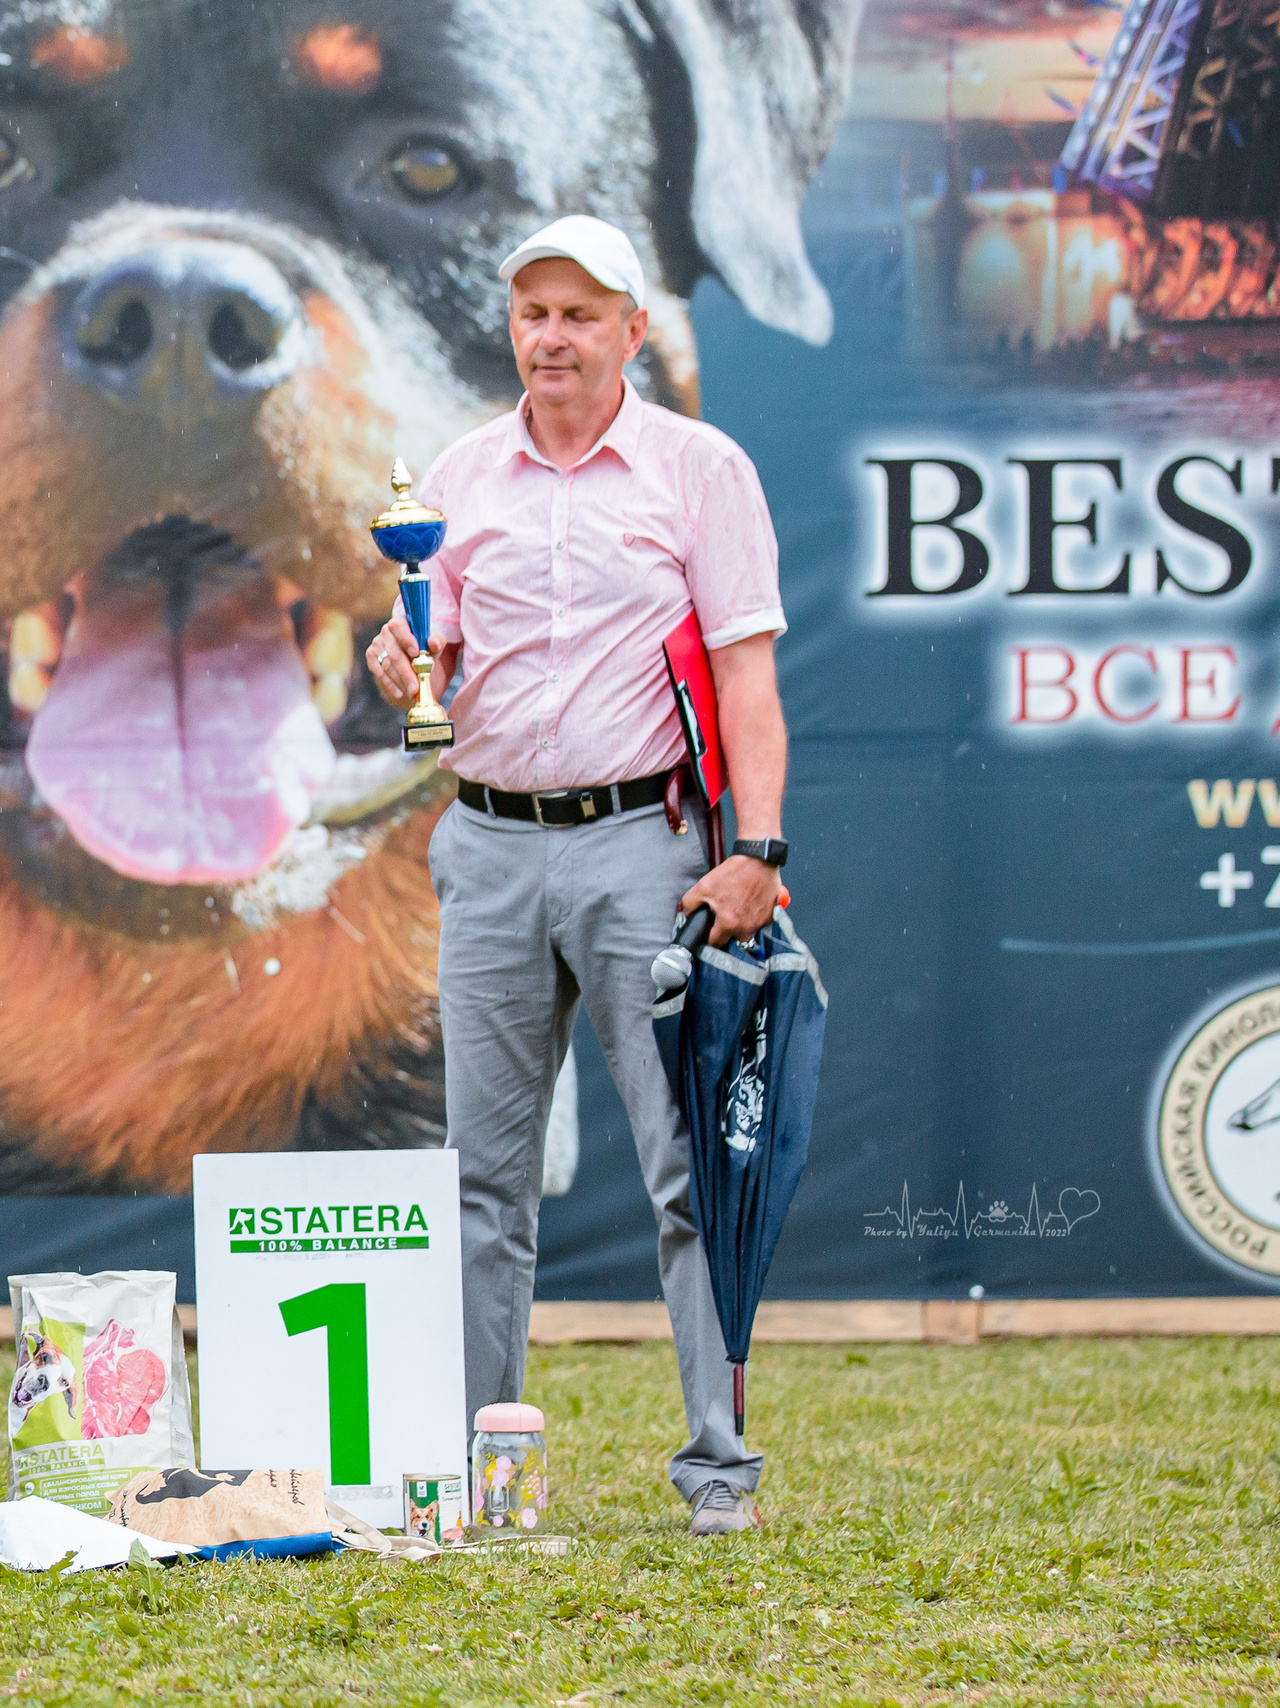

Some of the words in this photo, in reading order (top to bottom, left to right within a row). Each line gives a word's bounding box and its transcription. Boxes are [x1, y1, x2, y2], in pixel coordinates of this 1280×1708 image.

[1193, 1002, 1280, 1075] КИНОЛ
[260, 1204, 429, 1235] STATERA
[258, 1240, 303, 1252] 100%
[312, 1238, 398, 1250] BALANCE
[278, 1283, 371, 1486] 1
[30, 1444, 104, 1466] STATERA
